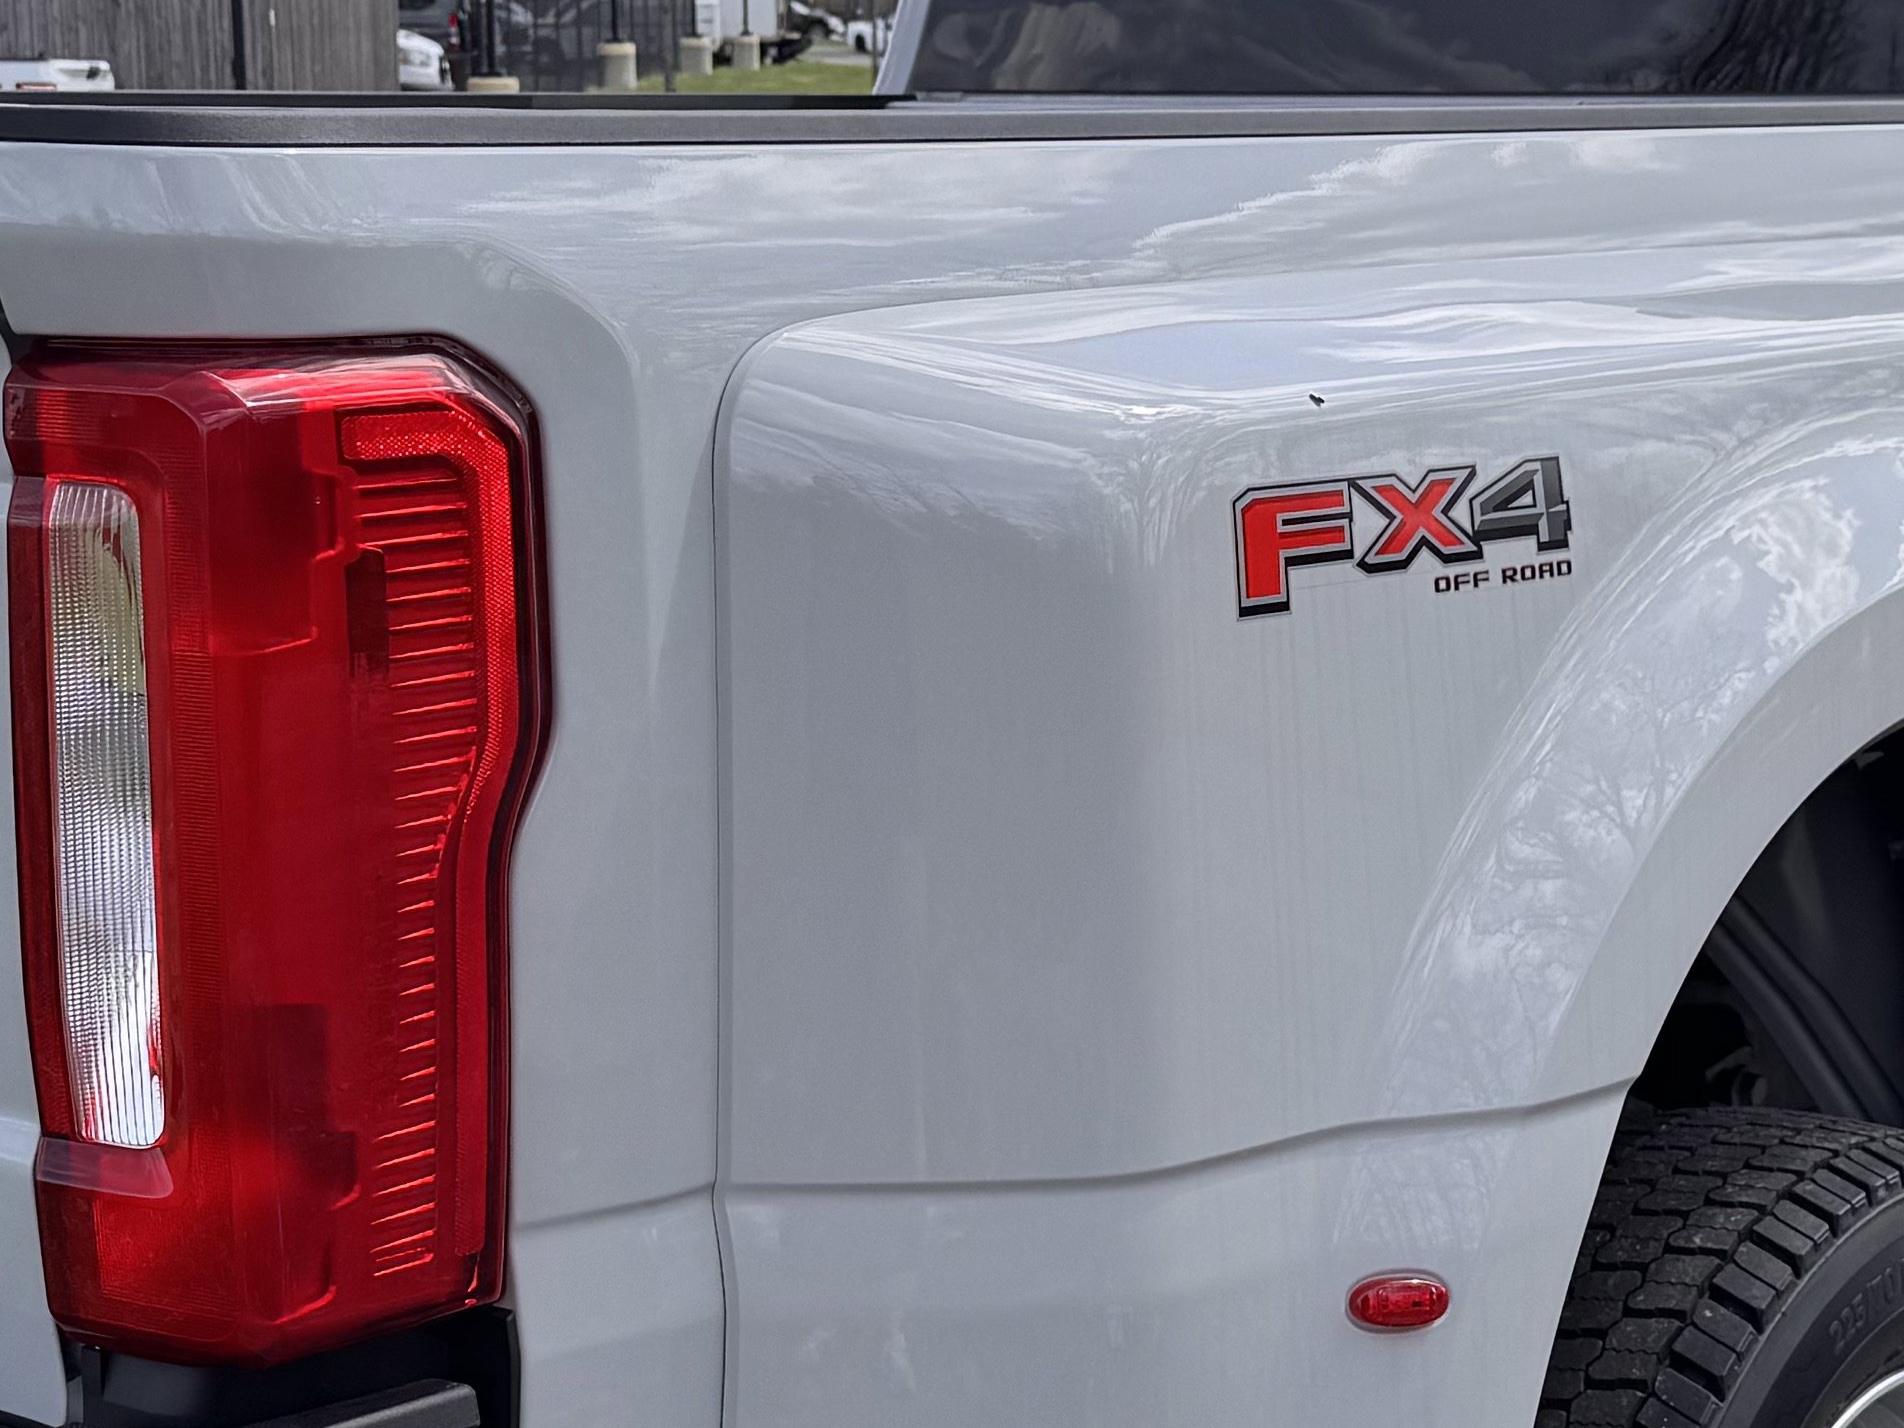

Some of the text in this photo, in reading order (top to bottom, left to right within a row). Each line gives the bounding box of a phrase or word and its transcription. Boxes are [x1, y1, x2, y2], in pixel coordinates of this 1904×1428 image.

[1231, 453, 1573, 621] FX4
[1434, 560, 1572, 593] OFF ROAD
